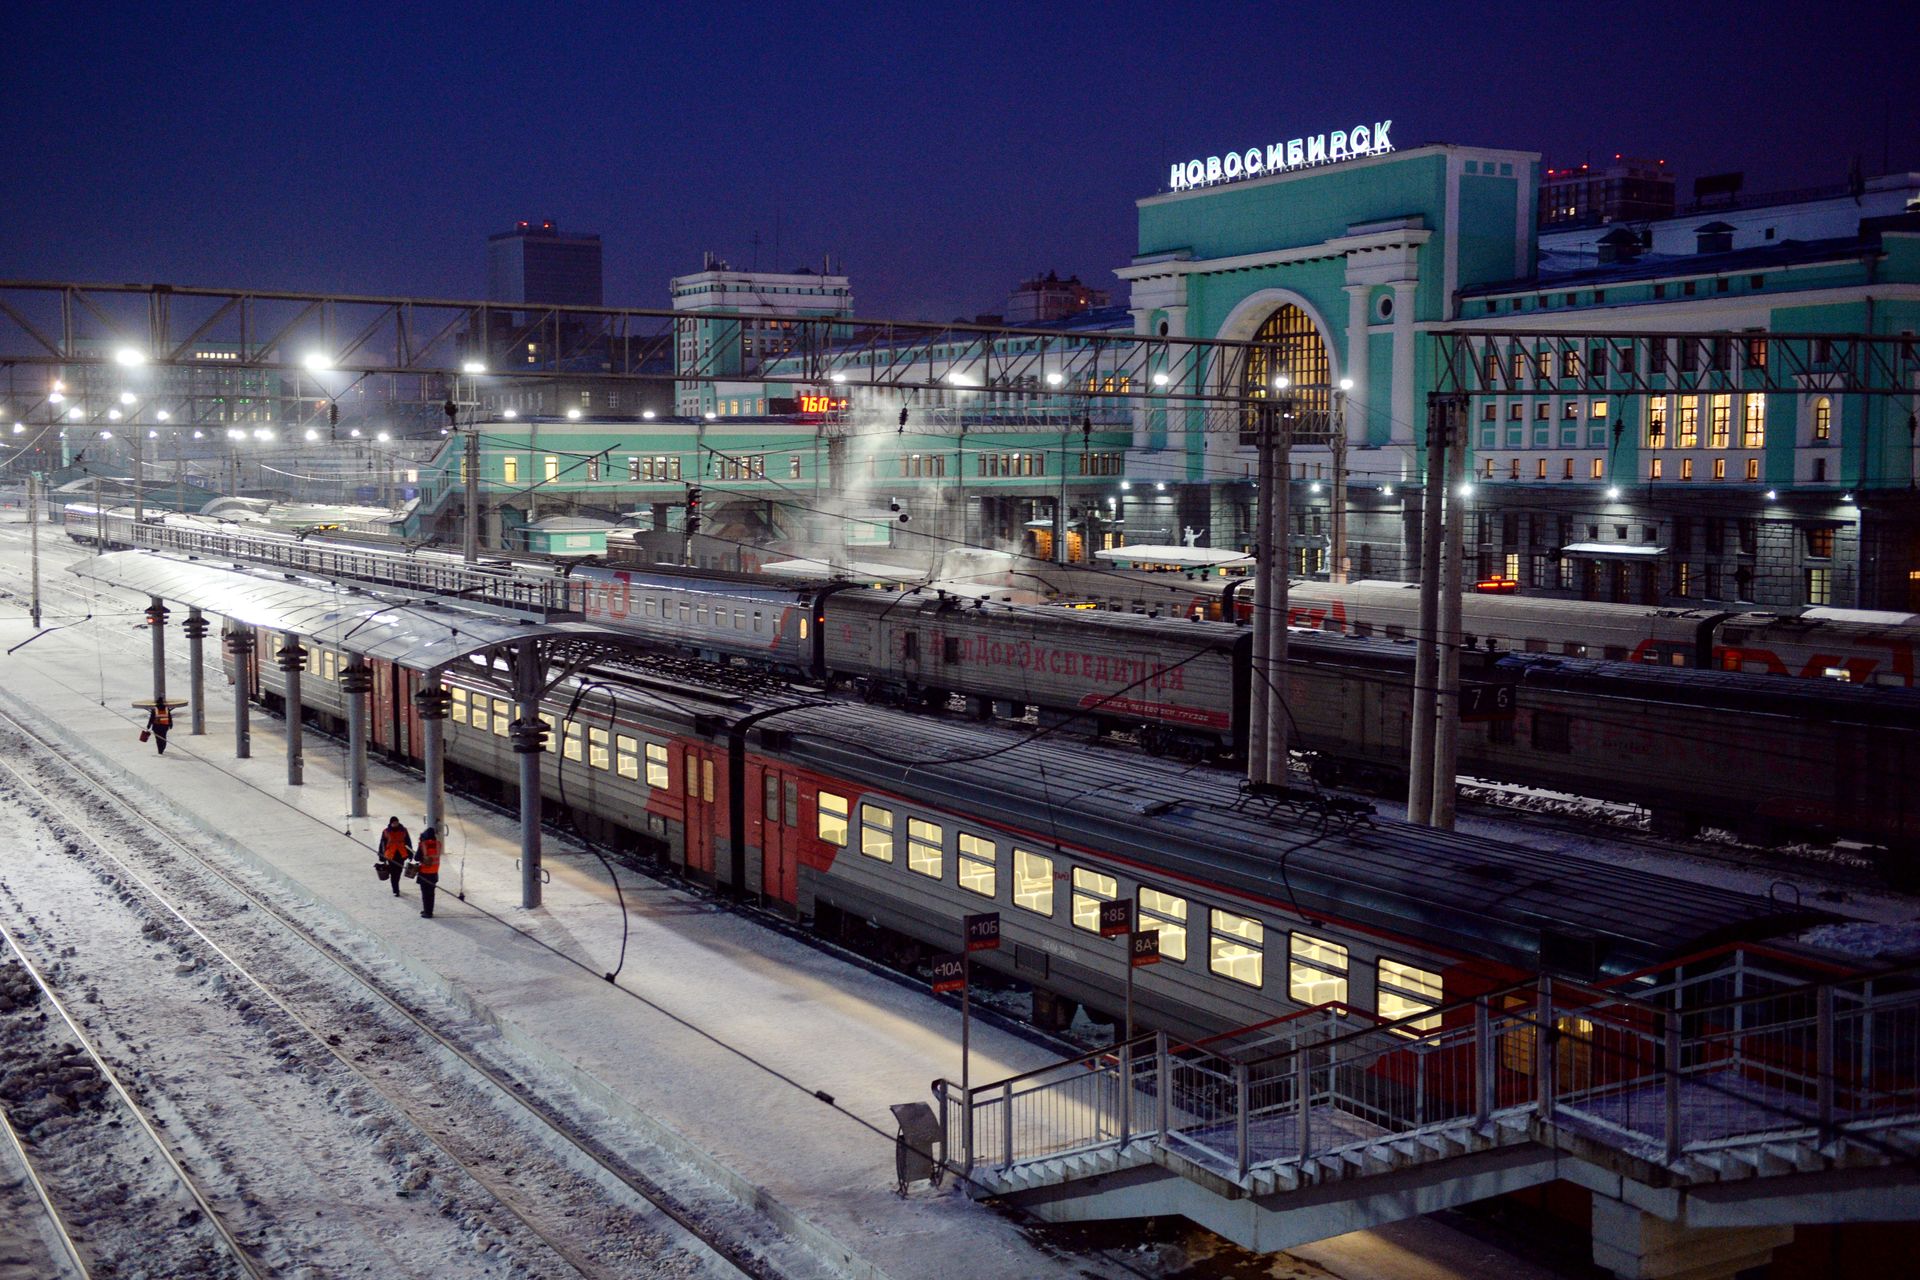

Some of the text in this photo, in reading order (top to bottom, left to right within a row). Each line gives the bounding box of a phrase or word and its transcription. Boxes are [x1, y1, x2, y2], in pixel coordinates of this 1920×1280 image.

[1170, 120, 1392, 187] НОВОСИБИРСК
[1471, 687, 1508, 710] 7 6
[1109, 907, 1126, 922] 8Б
[977, 920, 998, 935] 10Б
[1135, 939, 1153, 953] 8А
[941, 961, 963, 976] 10А
